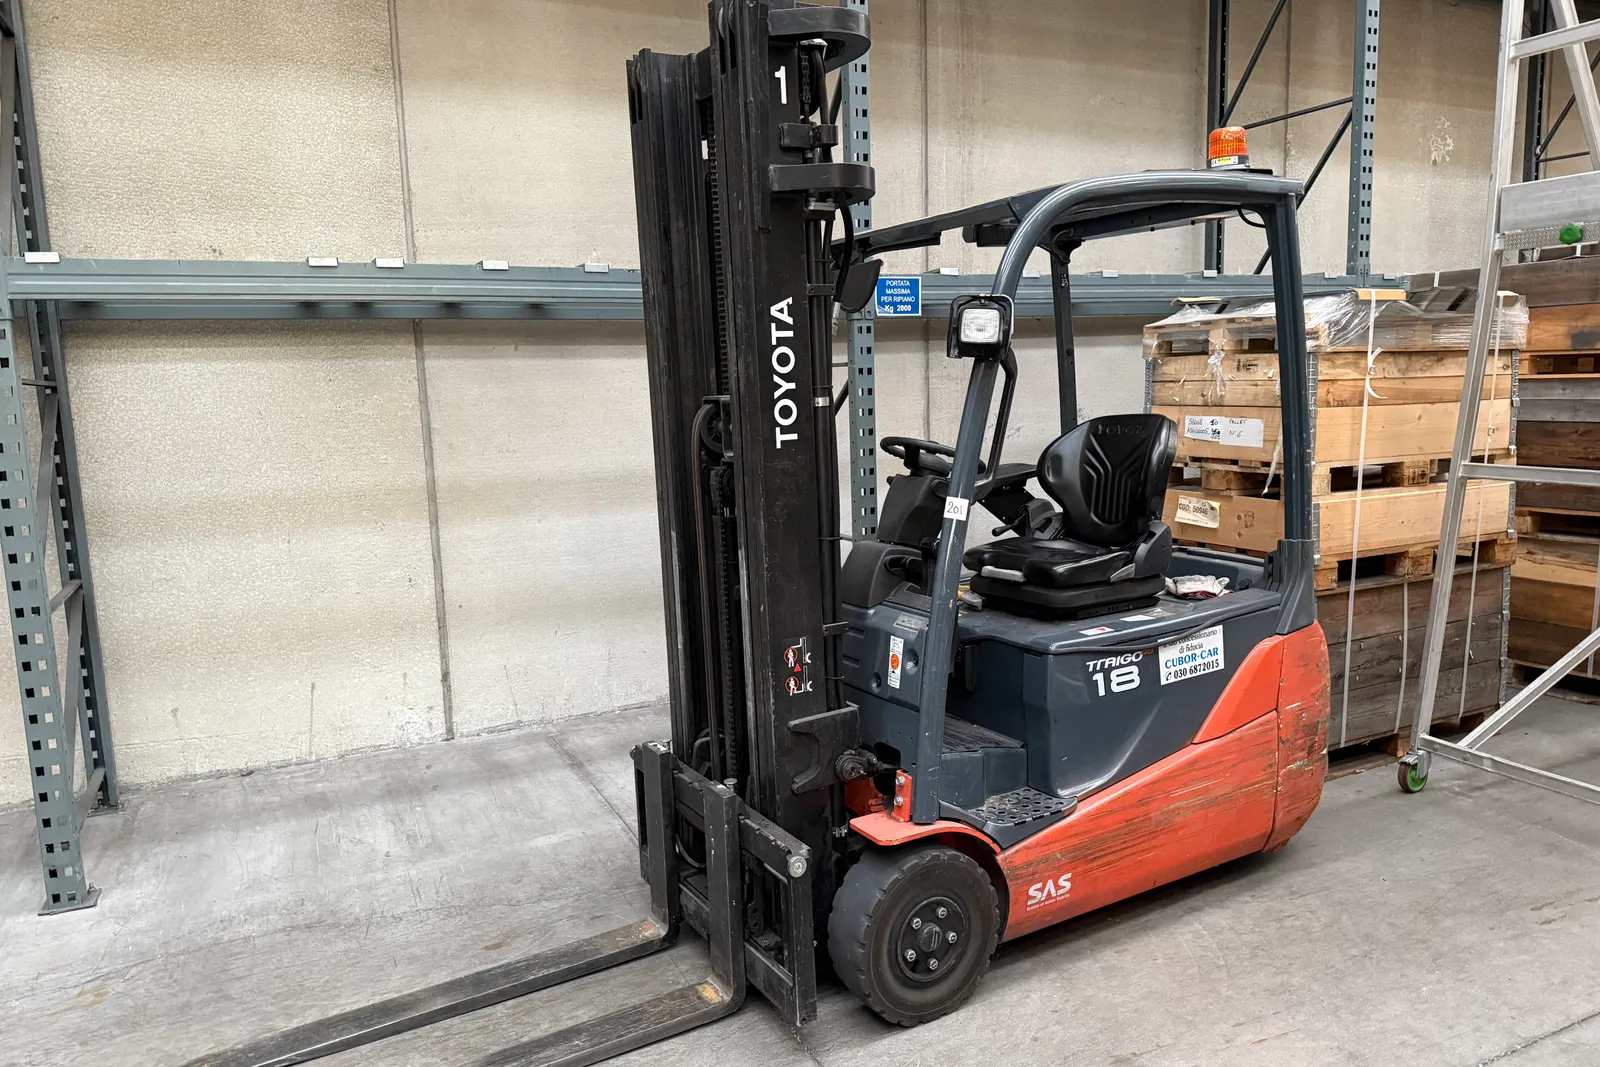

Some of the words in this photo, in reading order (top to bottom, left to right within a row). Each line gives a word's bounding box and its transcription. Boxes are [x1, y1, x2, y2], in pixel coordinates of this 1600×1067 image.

[774, 65, 787, 105] 1
[884, 304, 894, 313] Kg
[896, 304, 912, 312] 2000
[769, 296, 798, 449] TOYOTA
[1164, 647, 1219, 669] CUBOR-CAR
[1178, 645, 1185, 654] di
[1185, 642, 1204, 653] fiducia
[1092, 665, 1141, 697] 18
[1173, 667, 1188, 680] 030
[1188, 658, 1220, 675] 6872015
[1027, 872, 1072, 906] SAS
